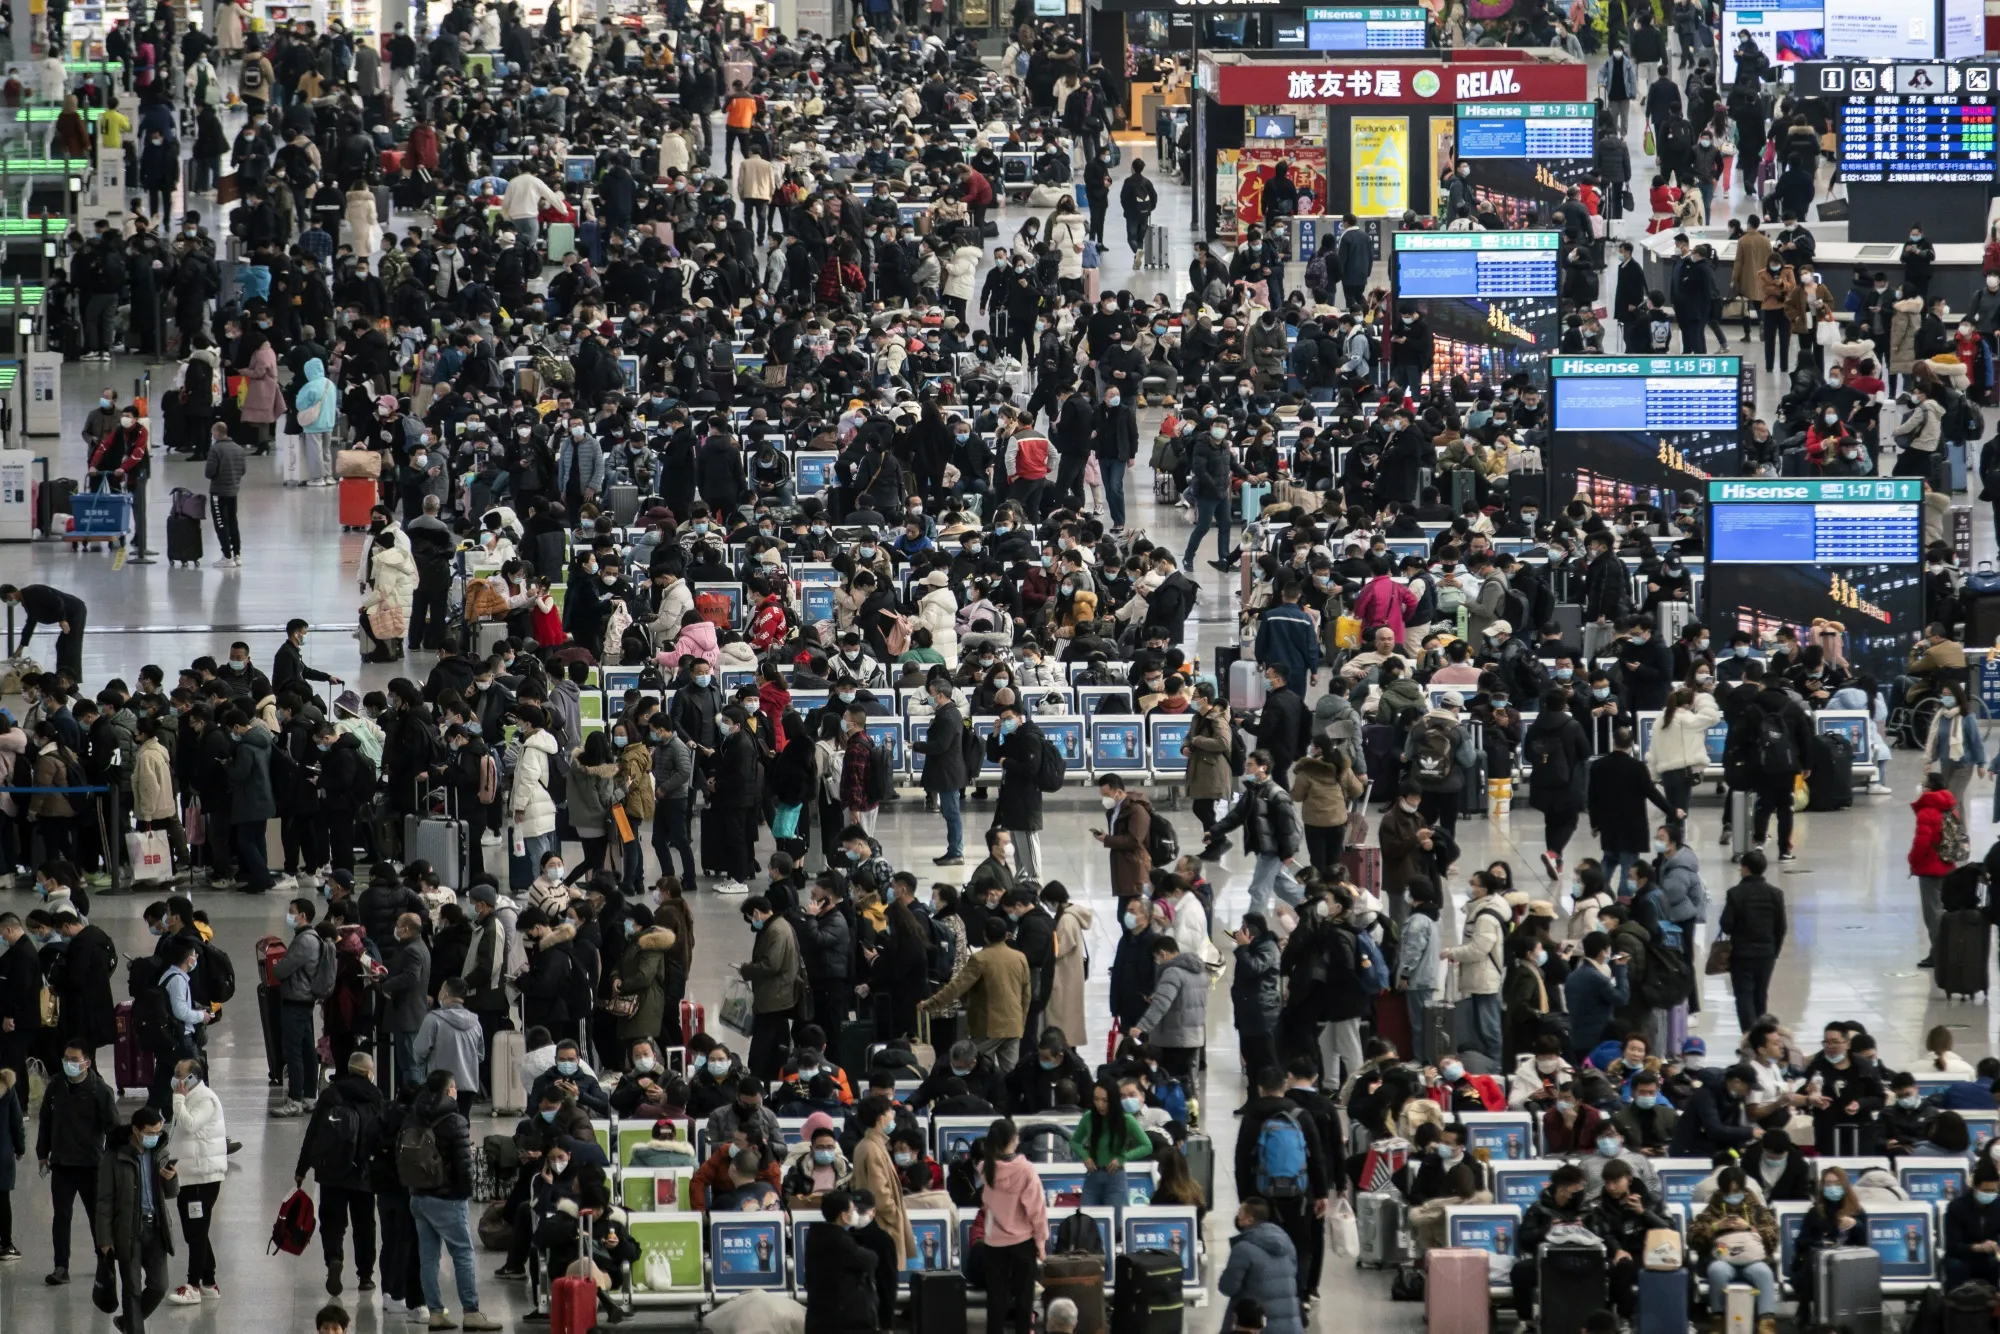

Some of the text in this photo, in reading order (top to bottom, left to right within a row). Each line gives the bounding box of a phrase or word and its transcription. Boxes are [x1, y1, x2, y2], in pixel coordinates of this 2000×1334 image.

[1314, 10, 1362, 19] Hisense
[1288, 71, 1402, 98] 旅友书屋
[1465, 106, 1522, 116] Hisense
[1549, 106, 1561, 115] 1-7
[1355, 124, 1387, 133] Fortune
[1405, 236, 1472, 248] Hisense
[1502, 236, 1521, 246] 1-11
[1563, 360, 1640, 373] Hisense
[1674, 360, 1696, 372] 1-15
[1722, 484, 1808, 498] Hisense
[1848, 484, 1871, 496] 1-17
